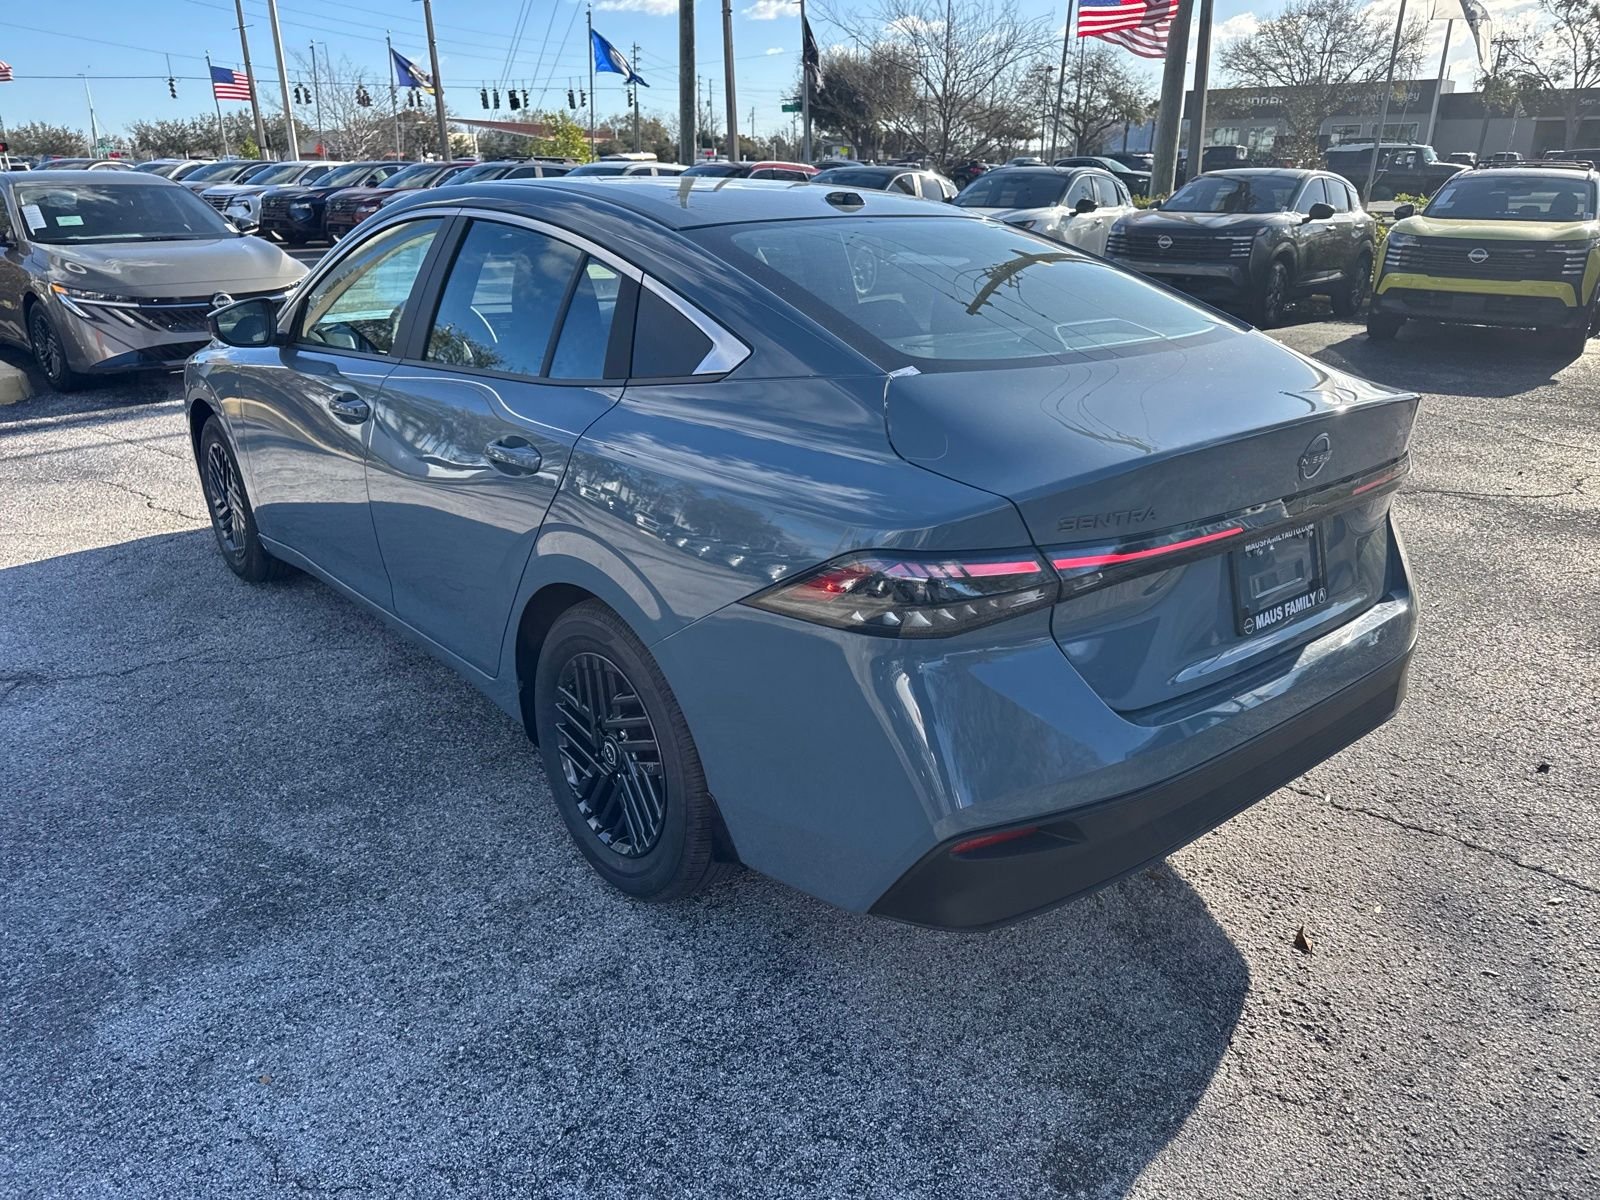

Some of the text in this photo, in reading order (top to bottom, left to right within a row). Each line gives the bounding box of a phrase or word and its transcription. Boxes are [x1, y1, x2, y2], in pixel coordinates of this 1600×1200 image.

[1226, 96, 1285, 105] YUNDAI
[1389, 91, 1420, 102] Rey
[1057, 506, 1156, 531] SENTRA
[1255, 591, 1317, 630] MAUS FAMILY
